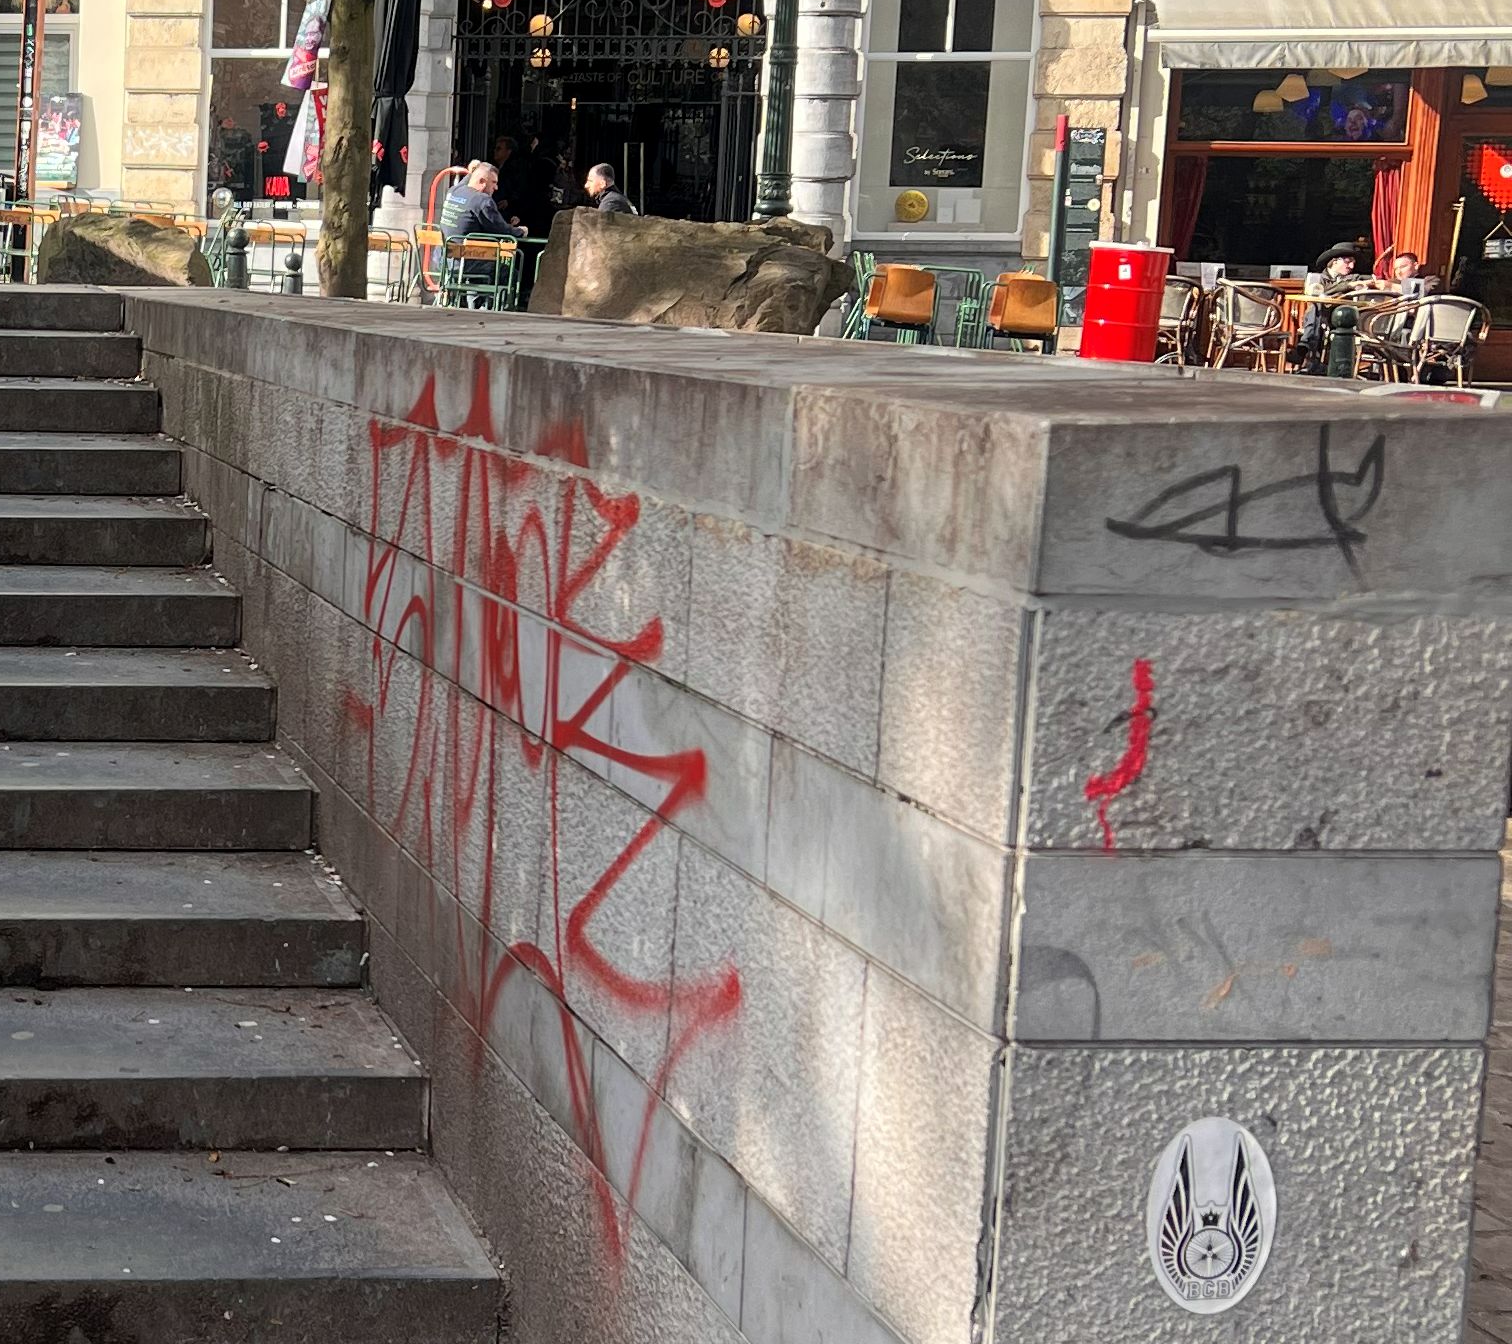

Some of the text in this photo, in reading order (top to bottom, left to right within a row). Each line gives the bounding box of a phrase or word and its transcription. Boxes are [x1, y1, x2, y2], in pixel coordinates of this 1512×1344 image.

[627, 69, 706, 85] CULTURE
[903, 146, 978, 167] Selections
[265, 176, 291, 197] KAWA
[1186, 1279, 1231, 1299] BCB
